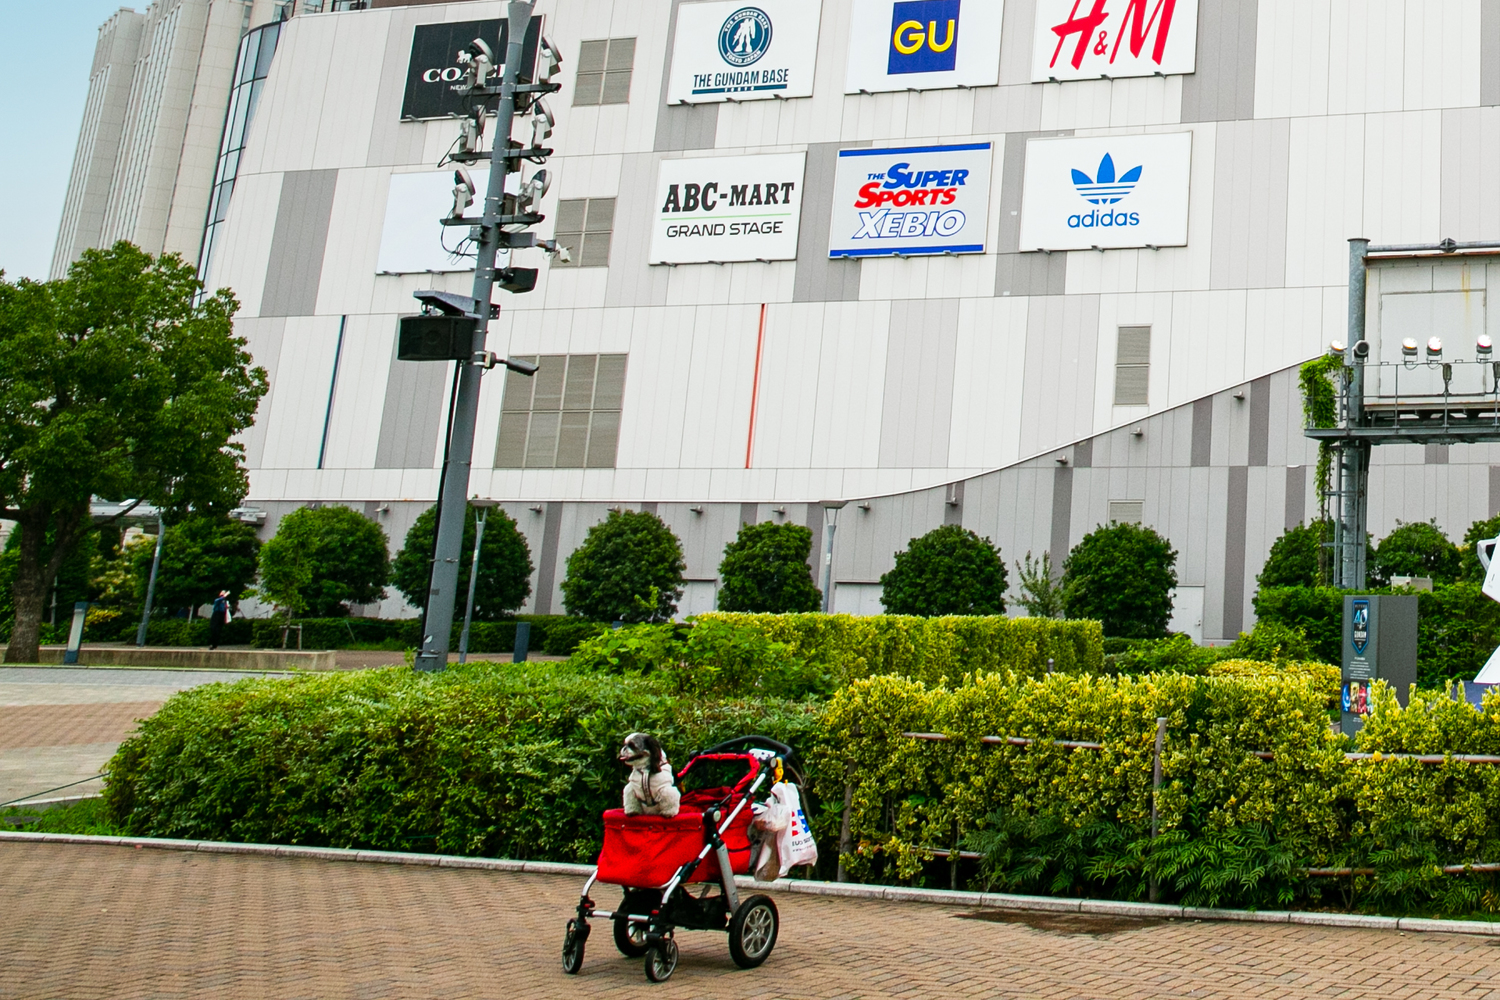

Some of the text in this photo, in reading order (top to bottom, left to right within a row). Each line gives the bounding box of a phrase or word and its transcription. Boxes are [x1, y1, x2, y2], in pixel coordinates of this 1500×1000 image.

[893, 19, 956, 55] GU
[693, 68, 790, 89] THE GUNDAM BASE
[867, 162, 970, 189] THE SUPER
[661, 181, 795, 214] ABC-MART
[853, 181, 958, 209] SPORTS
[666, 221, 784, 238] GRAND STAGE
[851, 209, 967, 240] XEBIO
[1067, 207, 1141, 229] adidas
